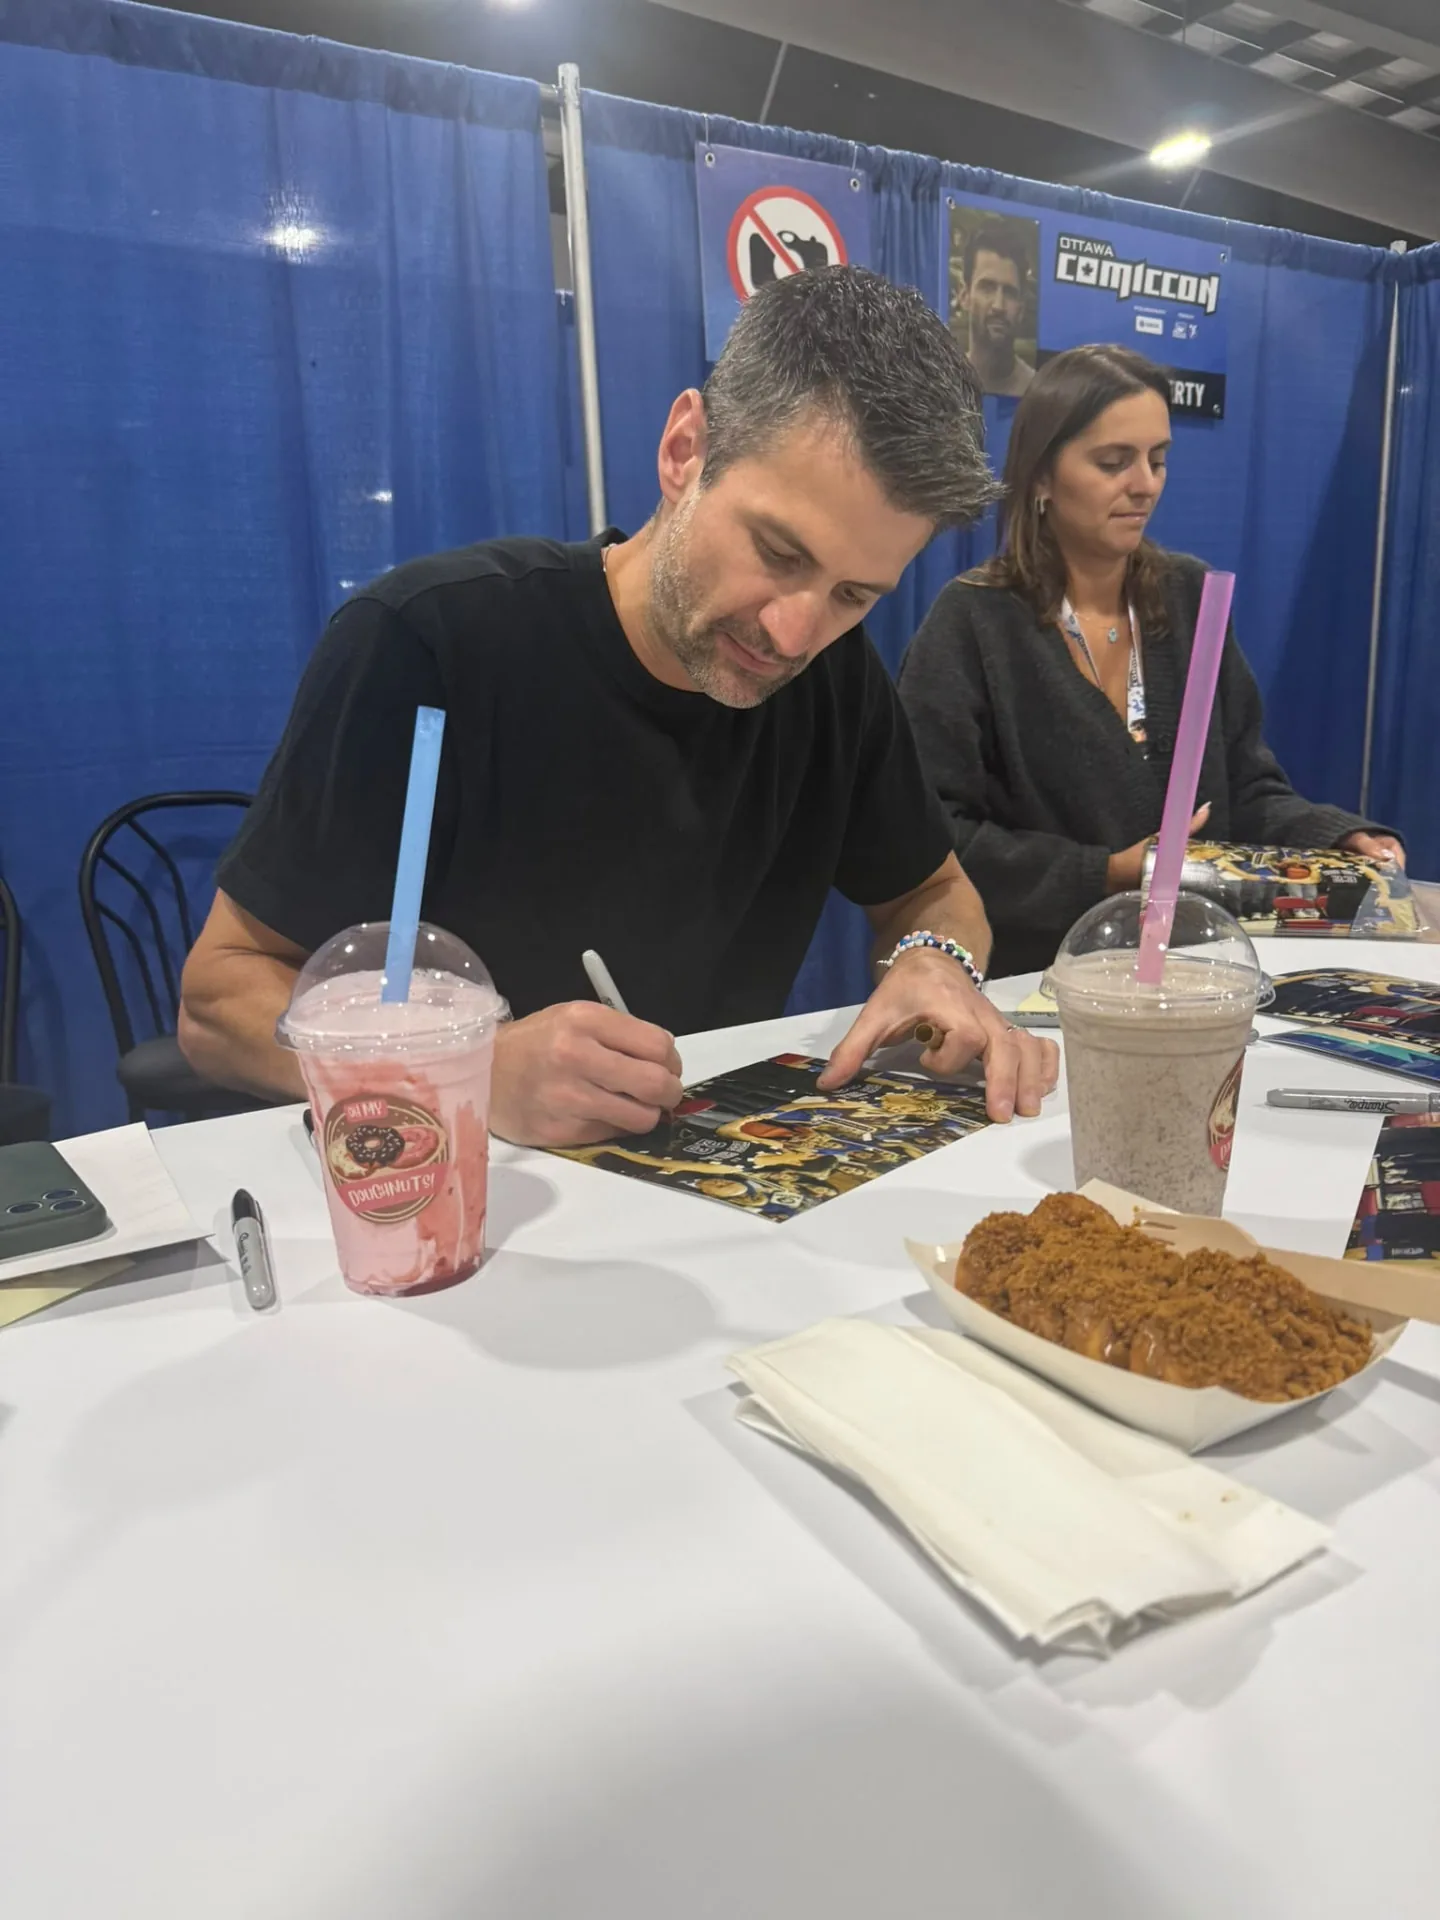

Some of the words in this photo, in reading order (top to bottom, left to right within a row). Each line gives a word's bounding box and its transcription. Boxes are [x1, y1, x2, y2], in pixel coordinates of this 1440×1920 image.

[1059, 236, 1115, 258] OTTAWA
[1056, 252, 1220, 314] COMICCON
[362, 1100, 382, 1117] MY
[347, 1172, 435, 1207] DOUGHNUTS!
